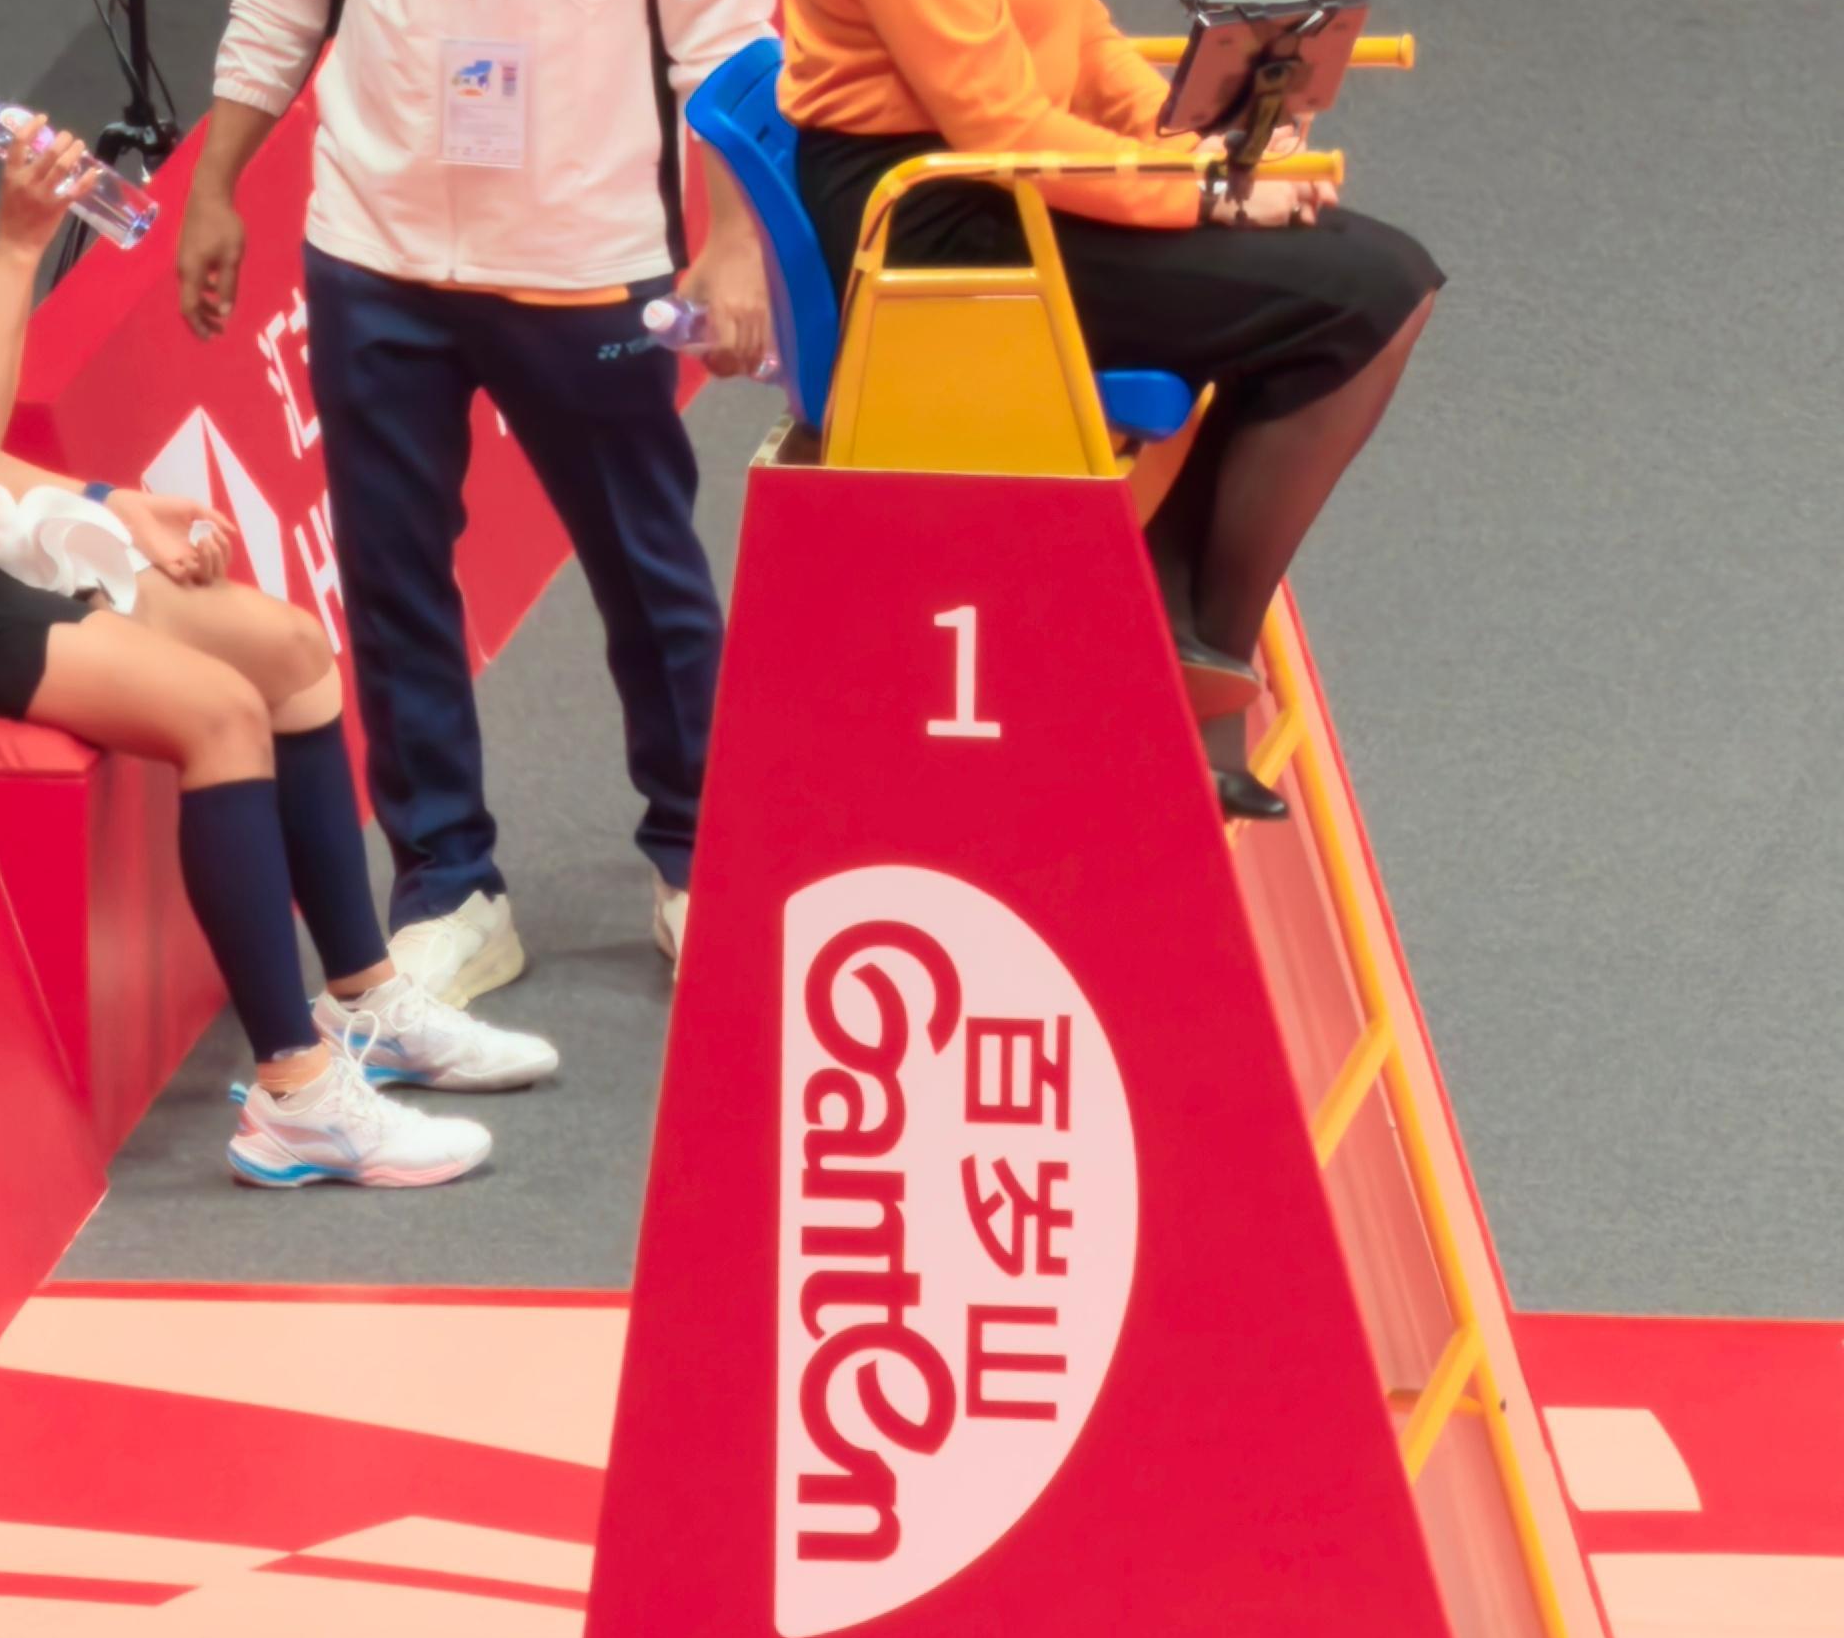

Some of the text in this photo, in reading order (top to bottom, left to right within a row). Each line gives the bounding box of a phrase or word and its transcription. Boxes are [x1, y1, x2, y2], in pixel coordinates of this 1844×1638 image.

[925, 604, 1002, 739] 1
[795, 918, 962, 1563] Ganten
[961, 1013, 1073, 1423] 百岁山
